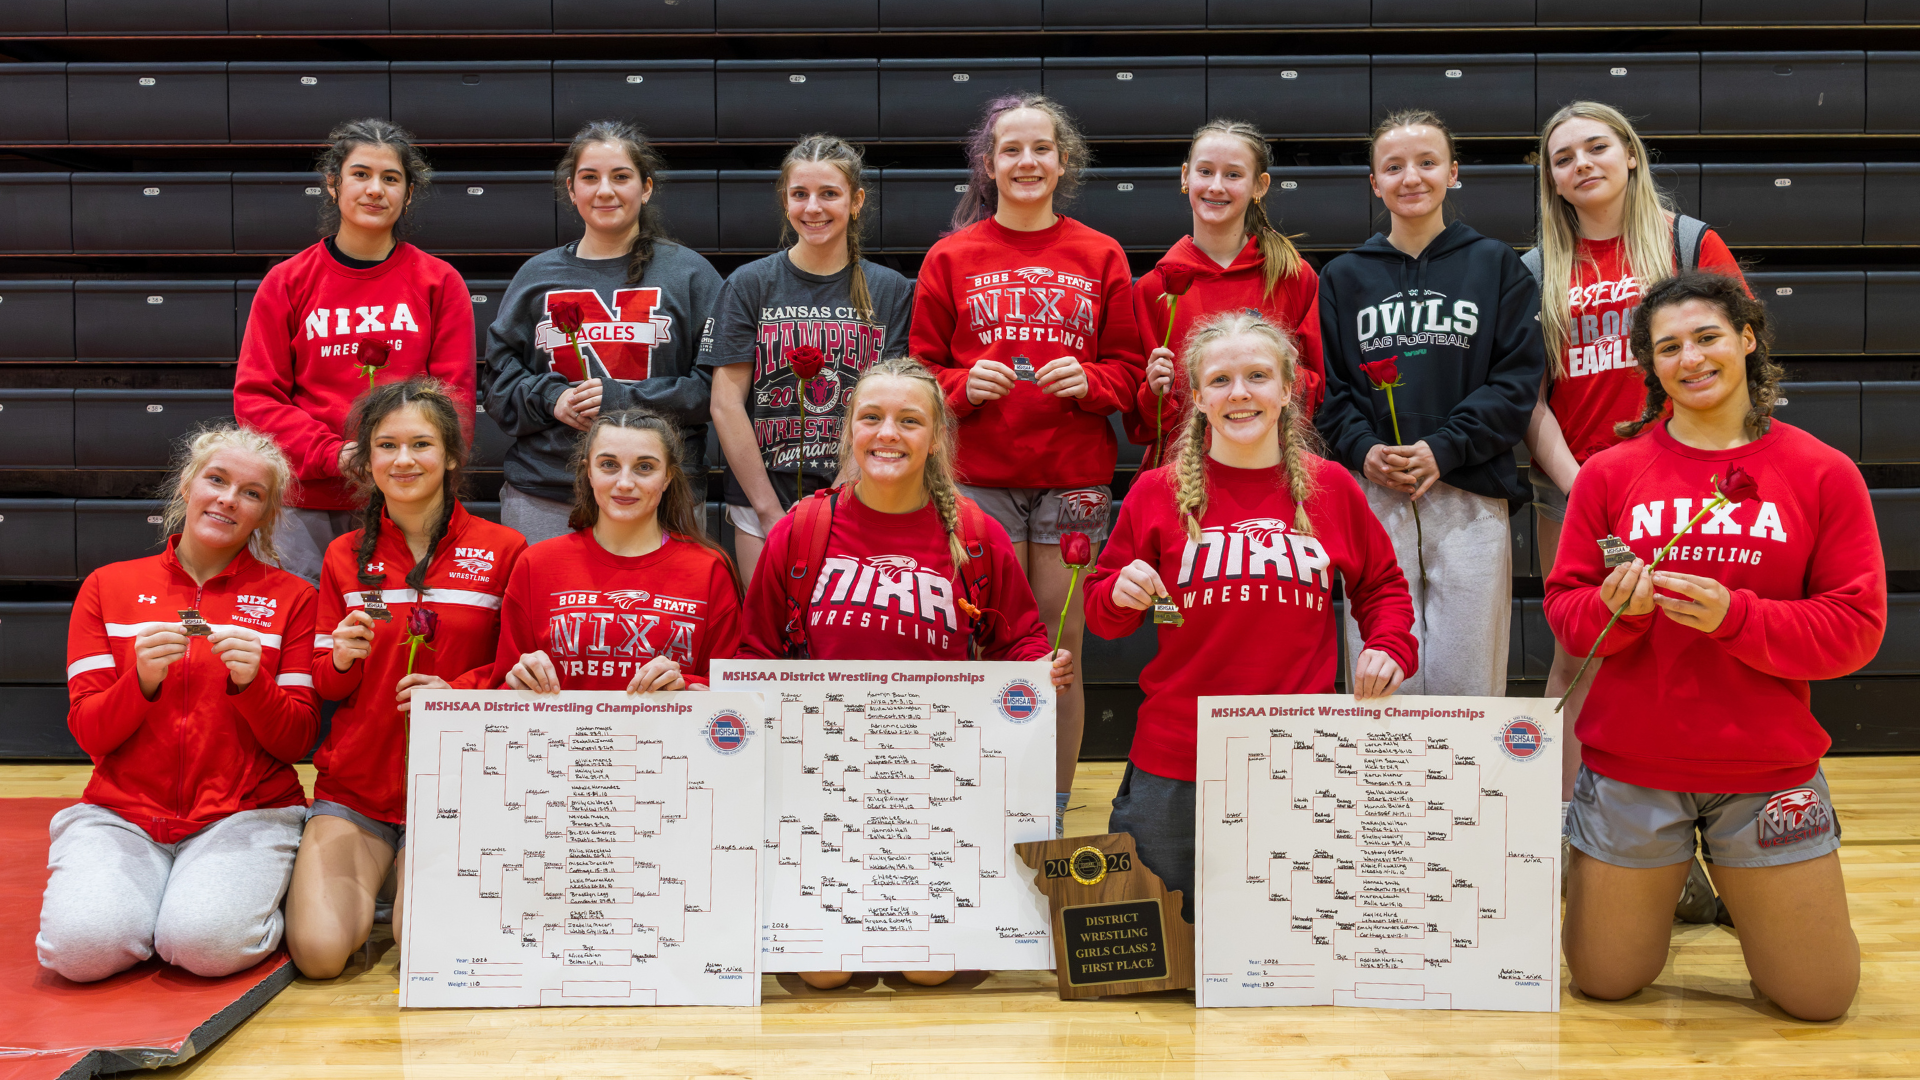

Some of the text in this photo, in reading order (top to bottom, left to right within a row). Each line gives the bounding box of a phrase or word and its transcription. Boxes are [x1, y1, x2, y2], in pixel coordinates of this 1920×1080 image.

[975, 273, 1092, 291] 2025 STATE
[762, 306, 831, 320] KANSAS
[967, 287, 1094, 336] NIXA
[1357, 298, 1478, 342] OWLS
[305, 303, 419, 341] NIXA
[566, 326, 634, 343] EAGLES
[978, 326, 1083, 350] WRESTLING
[1360, 332, 1470, 354] FLAG FOOTBALL
[320, 339, 402, 357] WRESG
[754, 320, 886, 388] STAMPEDE
[770, 386, 792, 407] 20
[754, 417, 841, 448] WRESTL
[1629, 498, 1787, 543] NIXA
[455, 547, 495, 561] NIXA
[1606, 546, 1626, 554] MSHSAA
[1653, 546, 1762, 565] WRESTLING
[1177, 532, 1330, 593] NIXA
[449, 572, 490, 582] WRESTLING
[237, 595, 277, 608] NIXA
[559, 594, 696, 614] 2025 STATE
[811, 557, 957, 633] NIXA
[1183, 585, 1323, 611] WRESTLING
[232, 614, 271, 627] WRESTLING
[811, 610, 949, 649] WRESTLING
[550, 612, 695, 667] NIXA
[560, 660, 641, 677] WRESTL
[723, 671, 985, 684] MSHSAA District Wrestling Championships
[424, 702, 693, 715] MSHSAA District Wrestling Championships
[1211, 707, 1485, 720] MSHSAA District Wrestling Championships
[1046, 859, 1068, 878] 20
[1108, 854, 1130, 871] 26
[1086, 913, 1138, 926] DISTRICT
[1080, 928, 1148, 942] WRESTLING
[1076, 943, 1156, 958] GIRLS CLASS 2
[1082, 959, 1154, 973] FIRST PLACE
